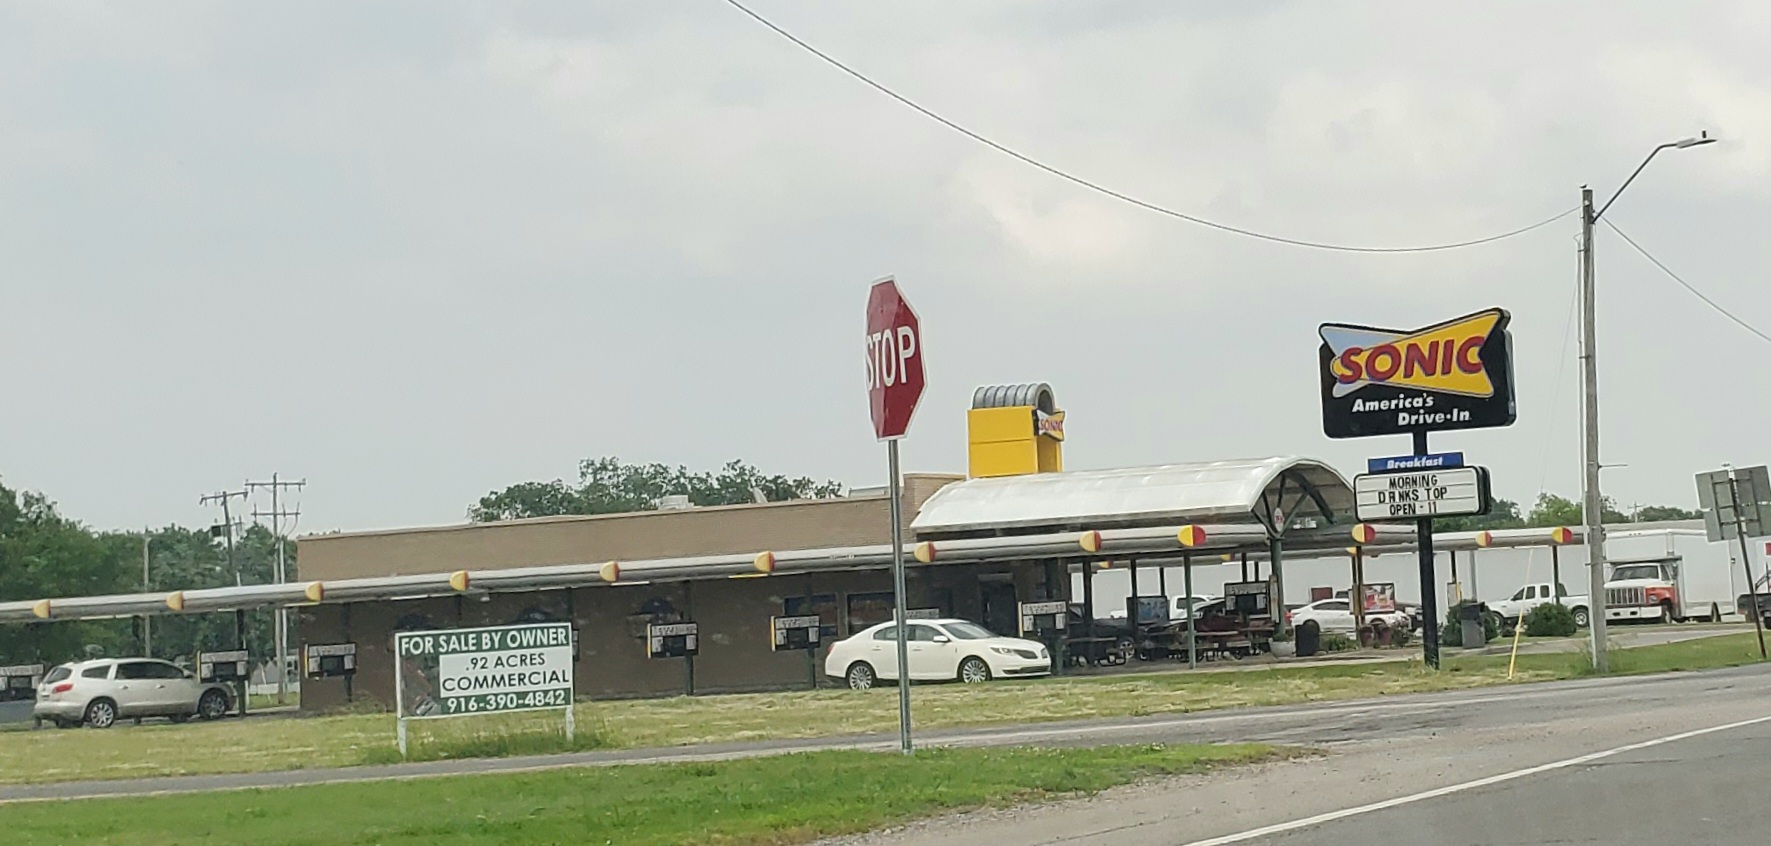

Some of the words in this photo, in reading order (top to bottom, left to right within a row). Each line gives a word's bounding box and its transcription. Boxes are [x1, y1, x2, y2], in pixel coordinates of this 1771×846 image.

[866, 325, 916, 391] STOP
[1337, 336, 1486, 384] SONIC
[1352, 393, 1434, 413] America's
[1386, 455, 1443, 469] Breakfast
[1389, 474, 1438, 489] MORNING
[1425, 487, 1448, 501] TOP
[1389, 503, 1416, 516] OPEN
[401, 637, 434, 656] FOR
[438, 633, 477, 653] SALE
[482, 631, 504, 649] BY
[506, 627, 568, 648] OWNER
[466, 656, 488, 671] .92
[494, 652, 546, 669] ACRES
[442, 669, 570, 692] COMMERCIAL
[447, 690, 566, 713] 916-390-4842
